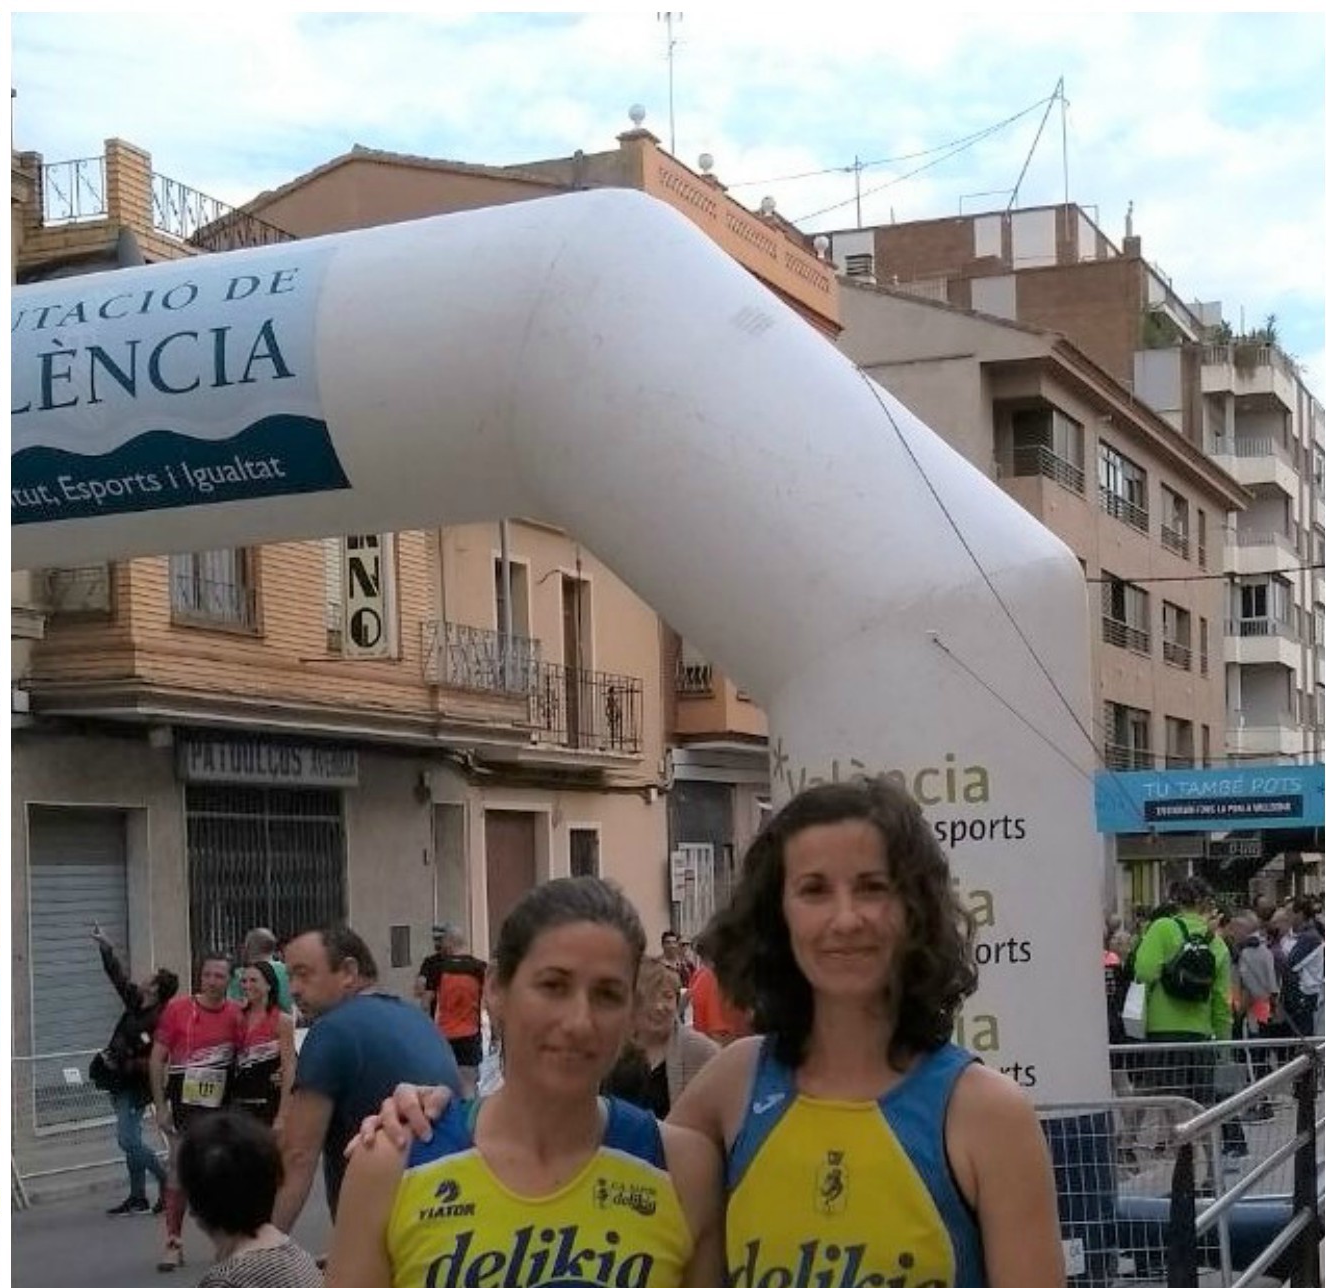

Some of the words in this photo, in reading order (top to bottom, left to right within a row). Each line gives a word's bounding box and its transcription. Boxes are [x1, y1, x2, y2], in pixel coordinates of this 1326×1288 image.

[223, 267, 300, 302] DE
[57, 472, 162, 505] Esports
[168, 465, 178, 489] i
[182, 455, 286, 491] Igualtat
[934, 815, 1026, 847] sports
[419, 1203, 476, 1220] VIATOR
